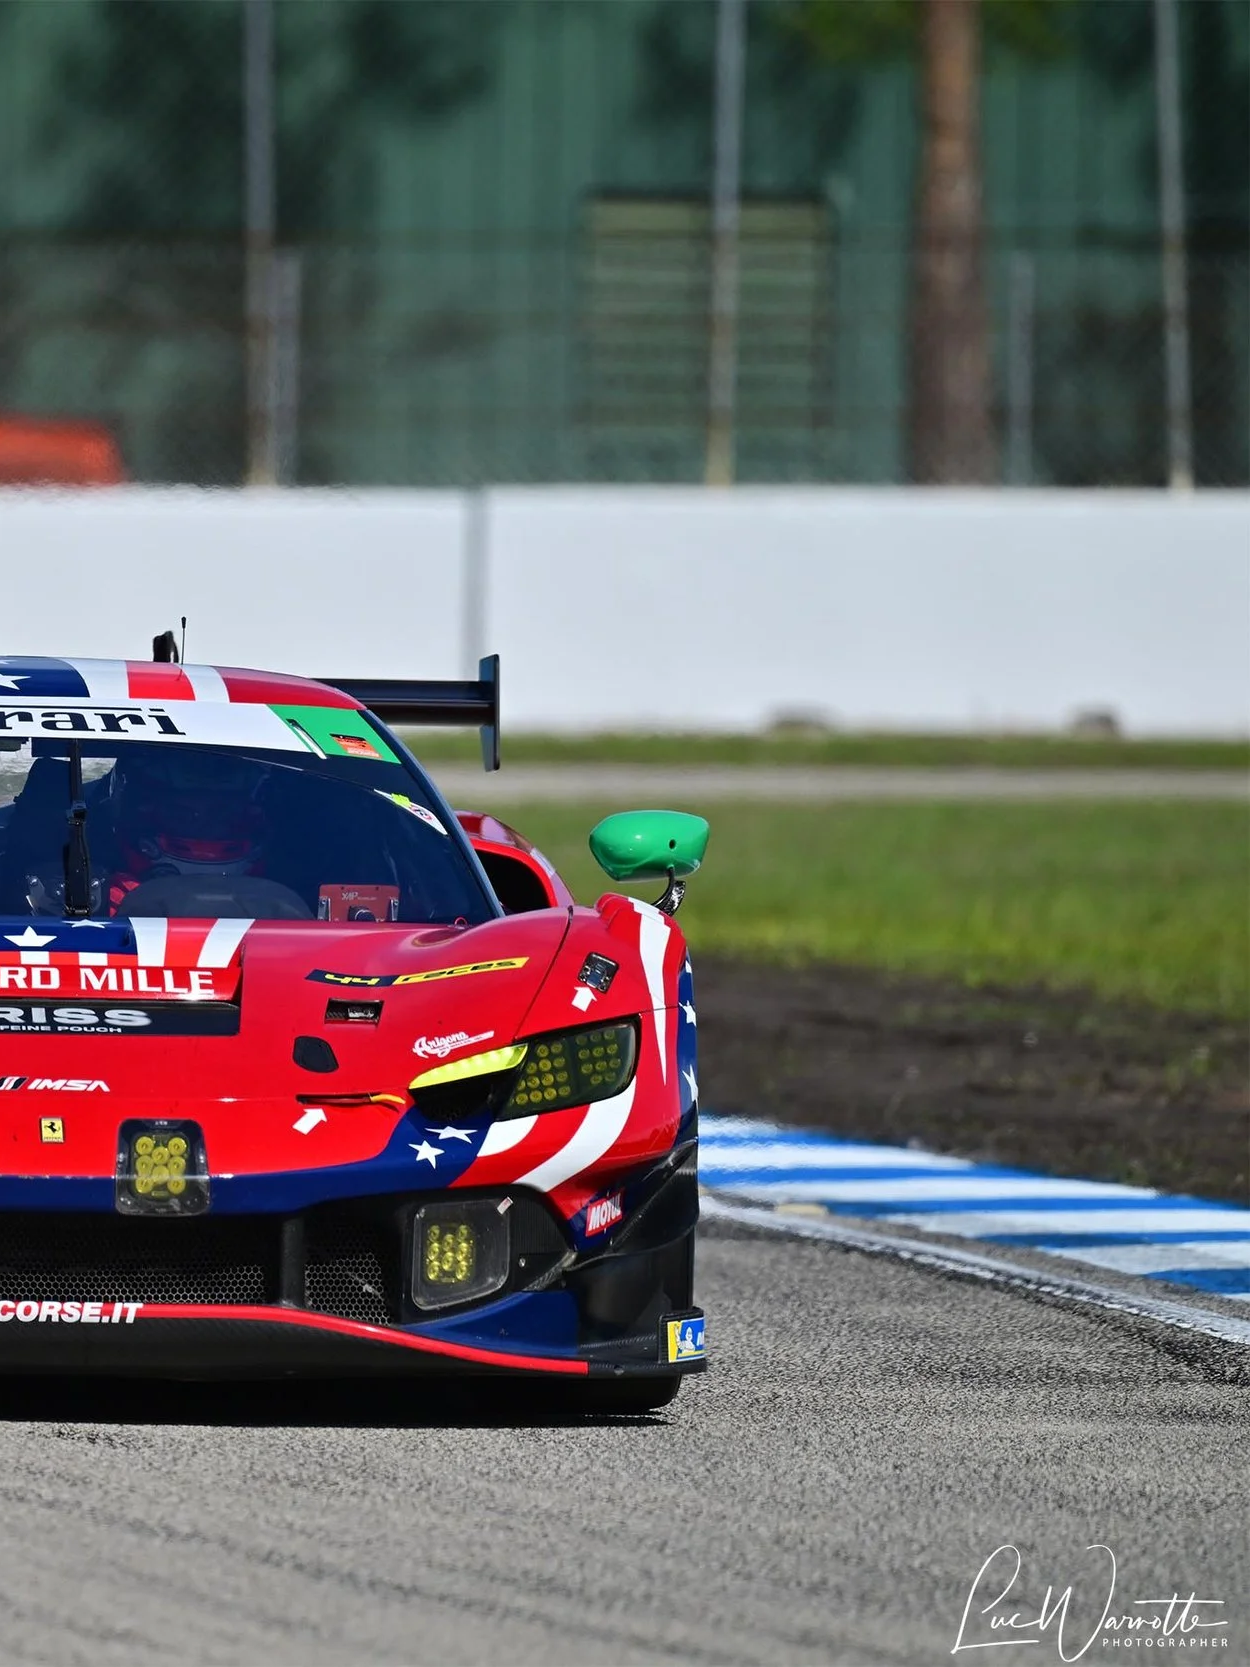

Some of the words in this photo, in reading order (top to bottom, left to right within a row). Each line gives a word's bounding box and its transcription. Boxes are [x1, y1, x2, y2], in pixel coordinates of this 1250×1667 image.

[79, 968, 215, 995] MILLE
[403, 960, 517, 982] races
[57, 1025, 122, 1033] POUCH
[27, 1078, 110, 1092] IMSA
[588, 1193, 621, 1231] MOTUL
